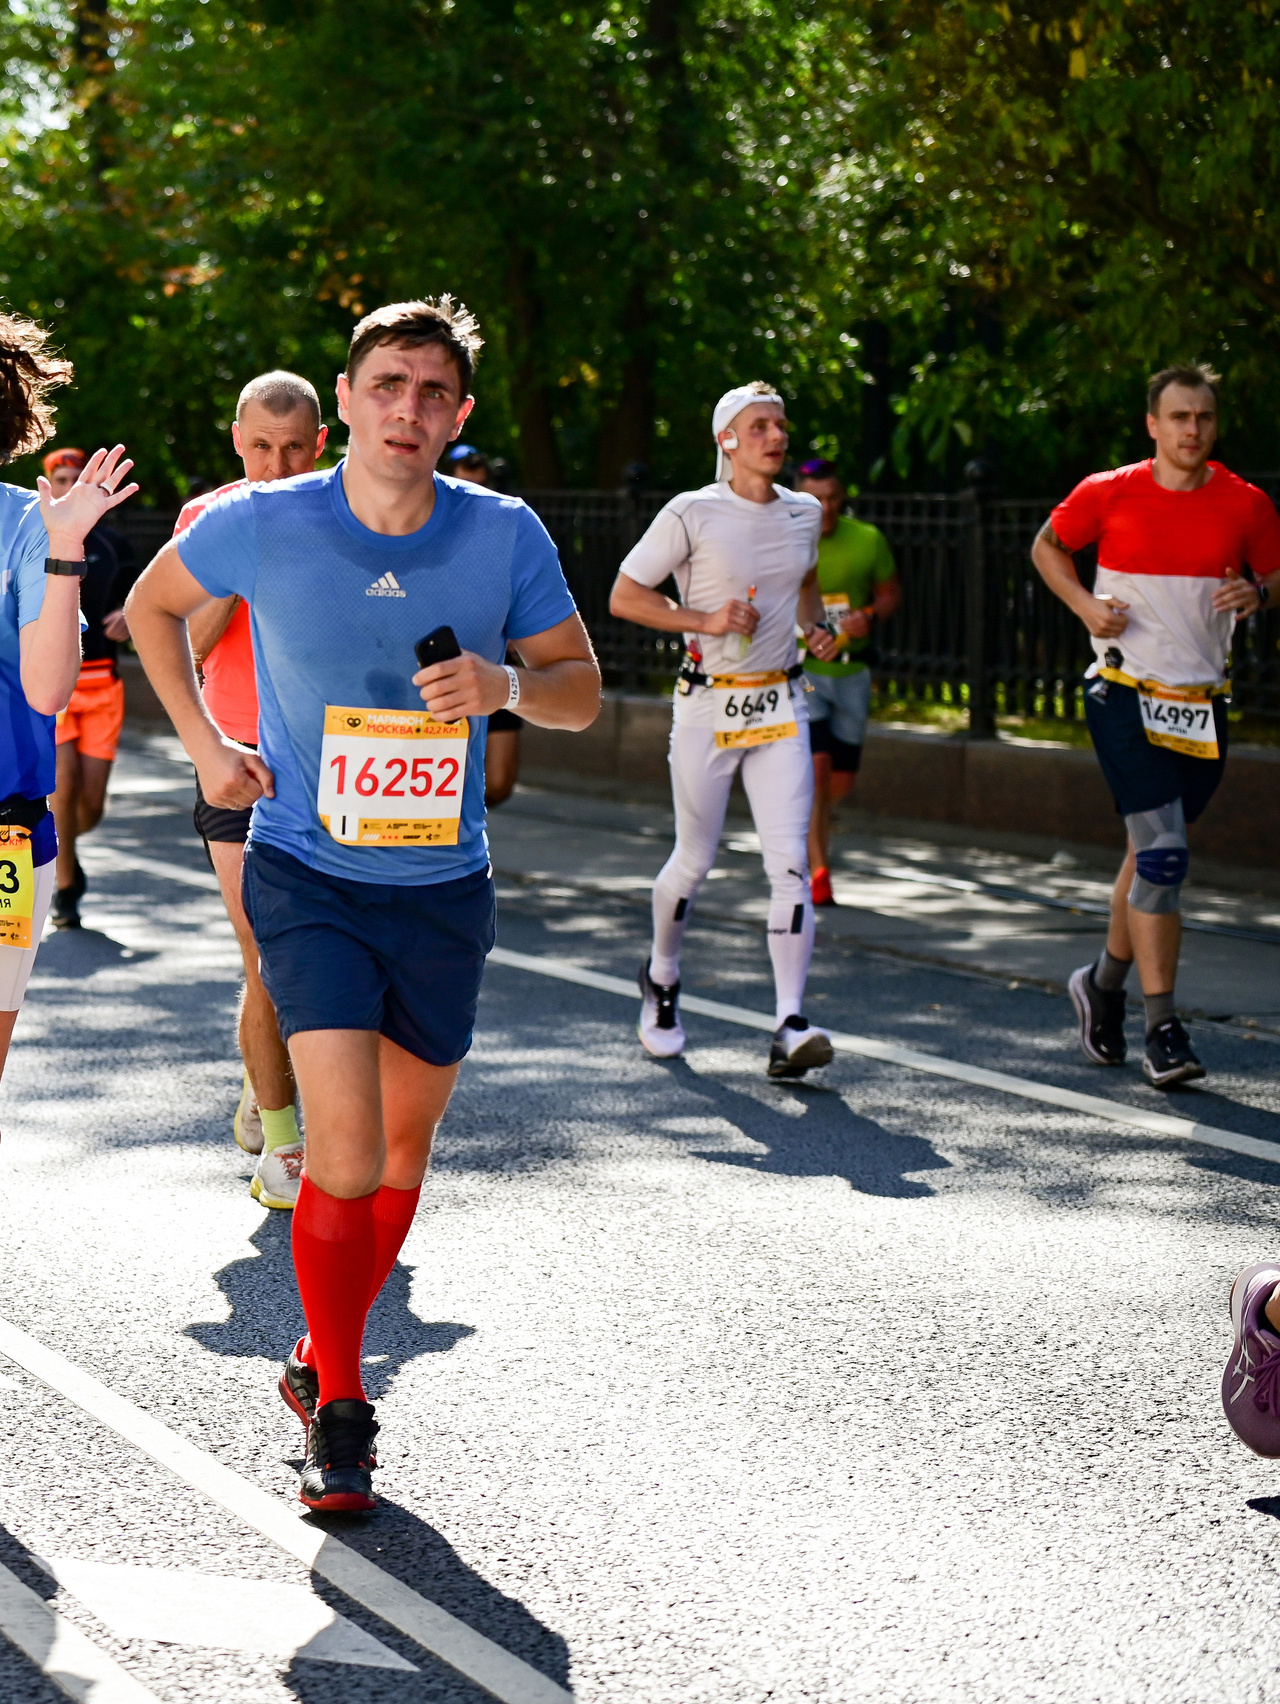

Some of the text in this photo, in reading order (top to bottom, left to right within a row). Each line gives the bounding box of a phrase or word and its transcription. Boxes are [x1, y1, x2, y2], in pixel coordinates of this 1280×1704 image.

[365, 588, 407, 598] adidas
[725, 689, 779, 717] 6649
[367, 714, 424, 726] МАРАФОН
[1142, 700, 1210, 731] 14997
[367, 724, 458, 735] МОСКВА 42,2 КМ
[330, 755, 460, 797] 16252
[8, 838, 23, 846] КМ
